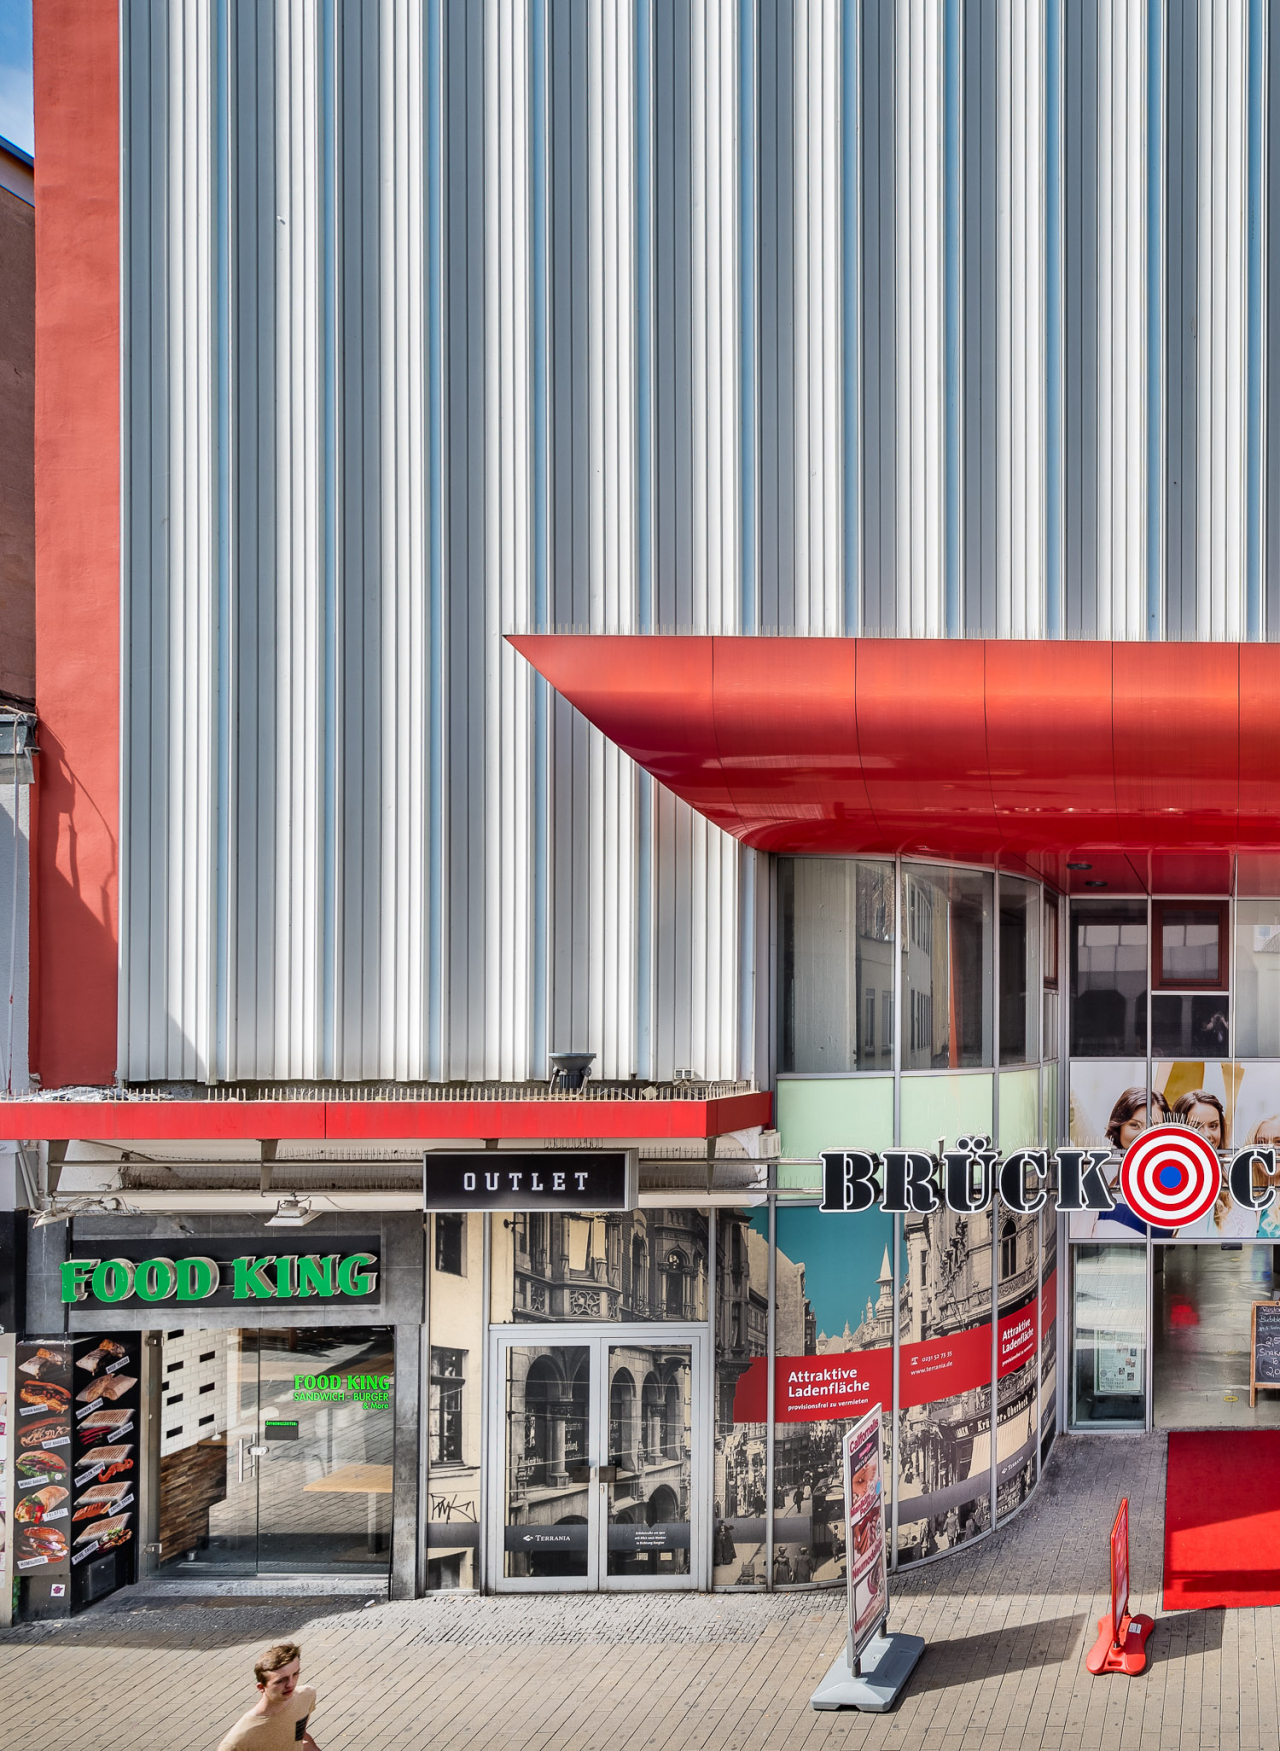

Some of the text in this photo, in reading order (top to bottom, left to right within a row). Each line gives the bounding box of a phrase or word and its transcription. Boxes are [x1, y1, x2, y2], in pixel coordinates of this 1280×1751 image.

[463, 1172, 588, 1191] OUTLET
[818, 1133, 1116, 1213] BRÜCK
[59, 1254, 378, 1303] FOOD KING
[1002, 1318, 1031, 1341] Attraktive
[1002, 1328, 1034, 1354] Ladenfläche
[788, 1367, 857, 1383] Attraktive
[910, 1361, 953, 1376] www.terrania.de
[294, 1375, 390, 1390] FOOD KING
[788, 1380, 870, 1398] Ladenfläche
[293, 1392, 345, 1401] SANDWICH
[353, 1392, 389, 1401] BURGER
[788, 1401, 829, 1412] provisionsfrei
[838, 1397, 869, 1407] vermieten
[362, 1402, 389, 1410] & More
